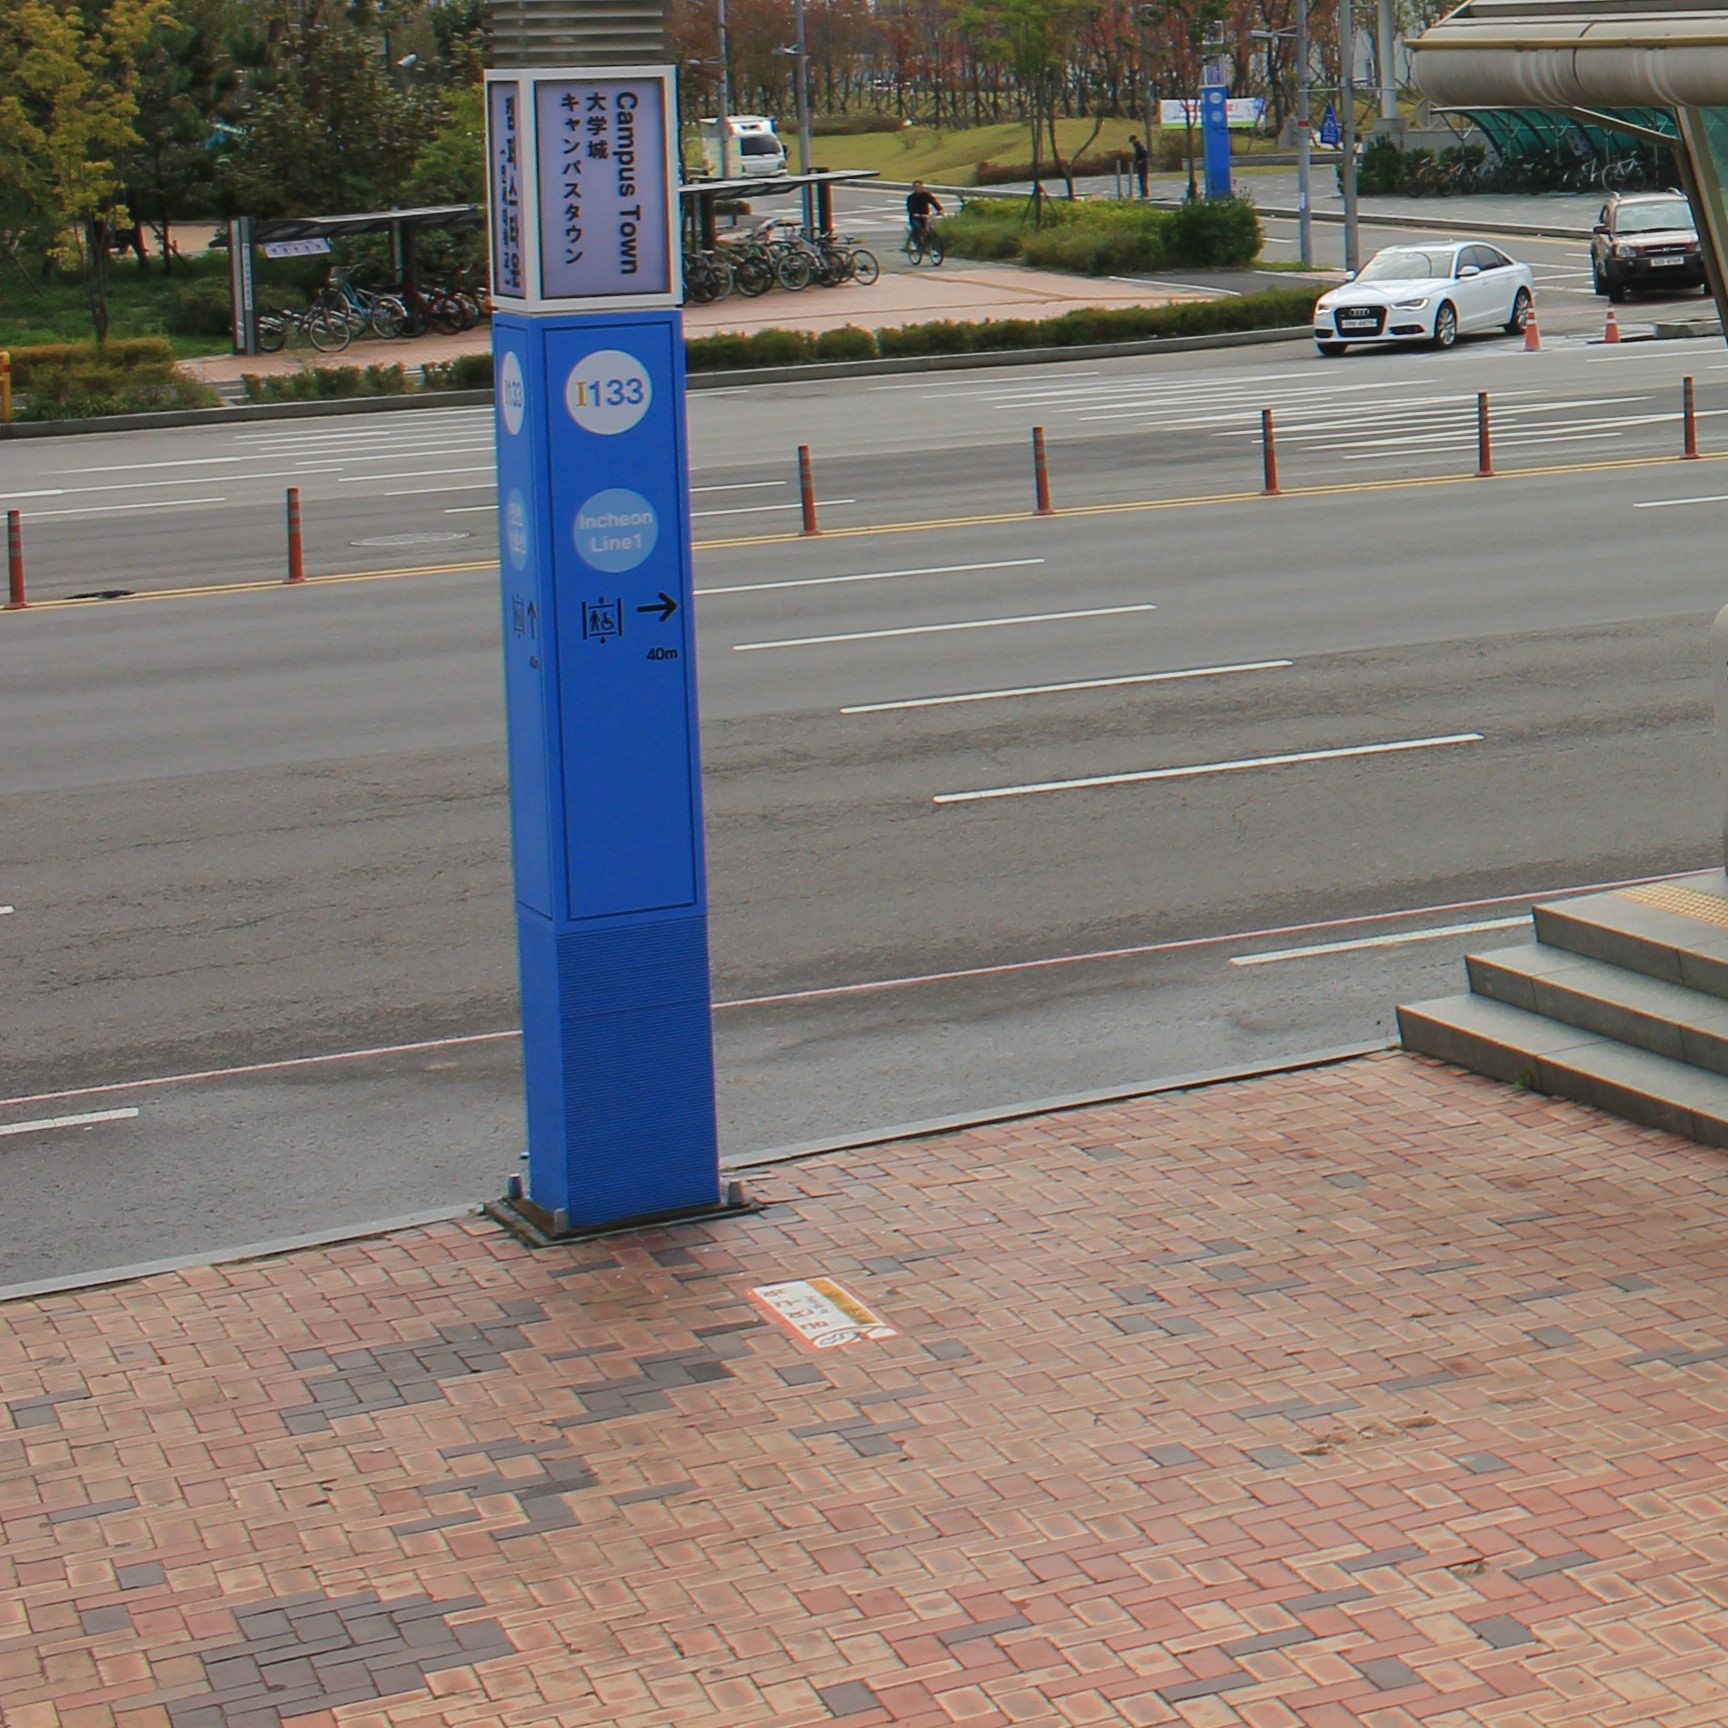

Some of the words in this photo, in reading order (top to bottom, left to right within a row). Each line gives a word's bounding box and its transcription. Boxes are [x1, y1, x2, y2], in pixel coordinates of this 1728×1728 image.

[586, 91, 608, 160] 大学城
[612, 91, 639, 198] Campus
[561, 92, 583, 265] キャンパスタウン
[619, 204, 641, 275] Town
[575, 377, 644, 407] I133
[579, 511, 654, 529] Incheon
[590, 532, 643, 553] Line1
[646, 646, 678, 661] 40m
